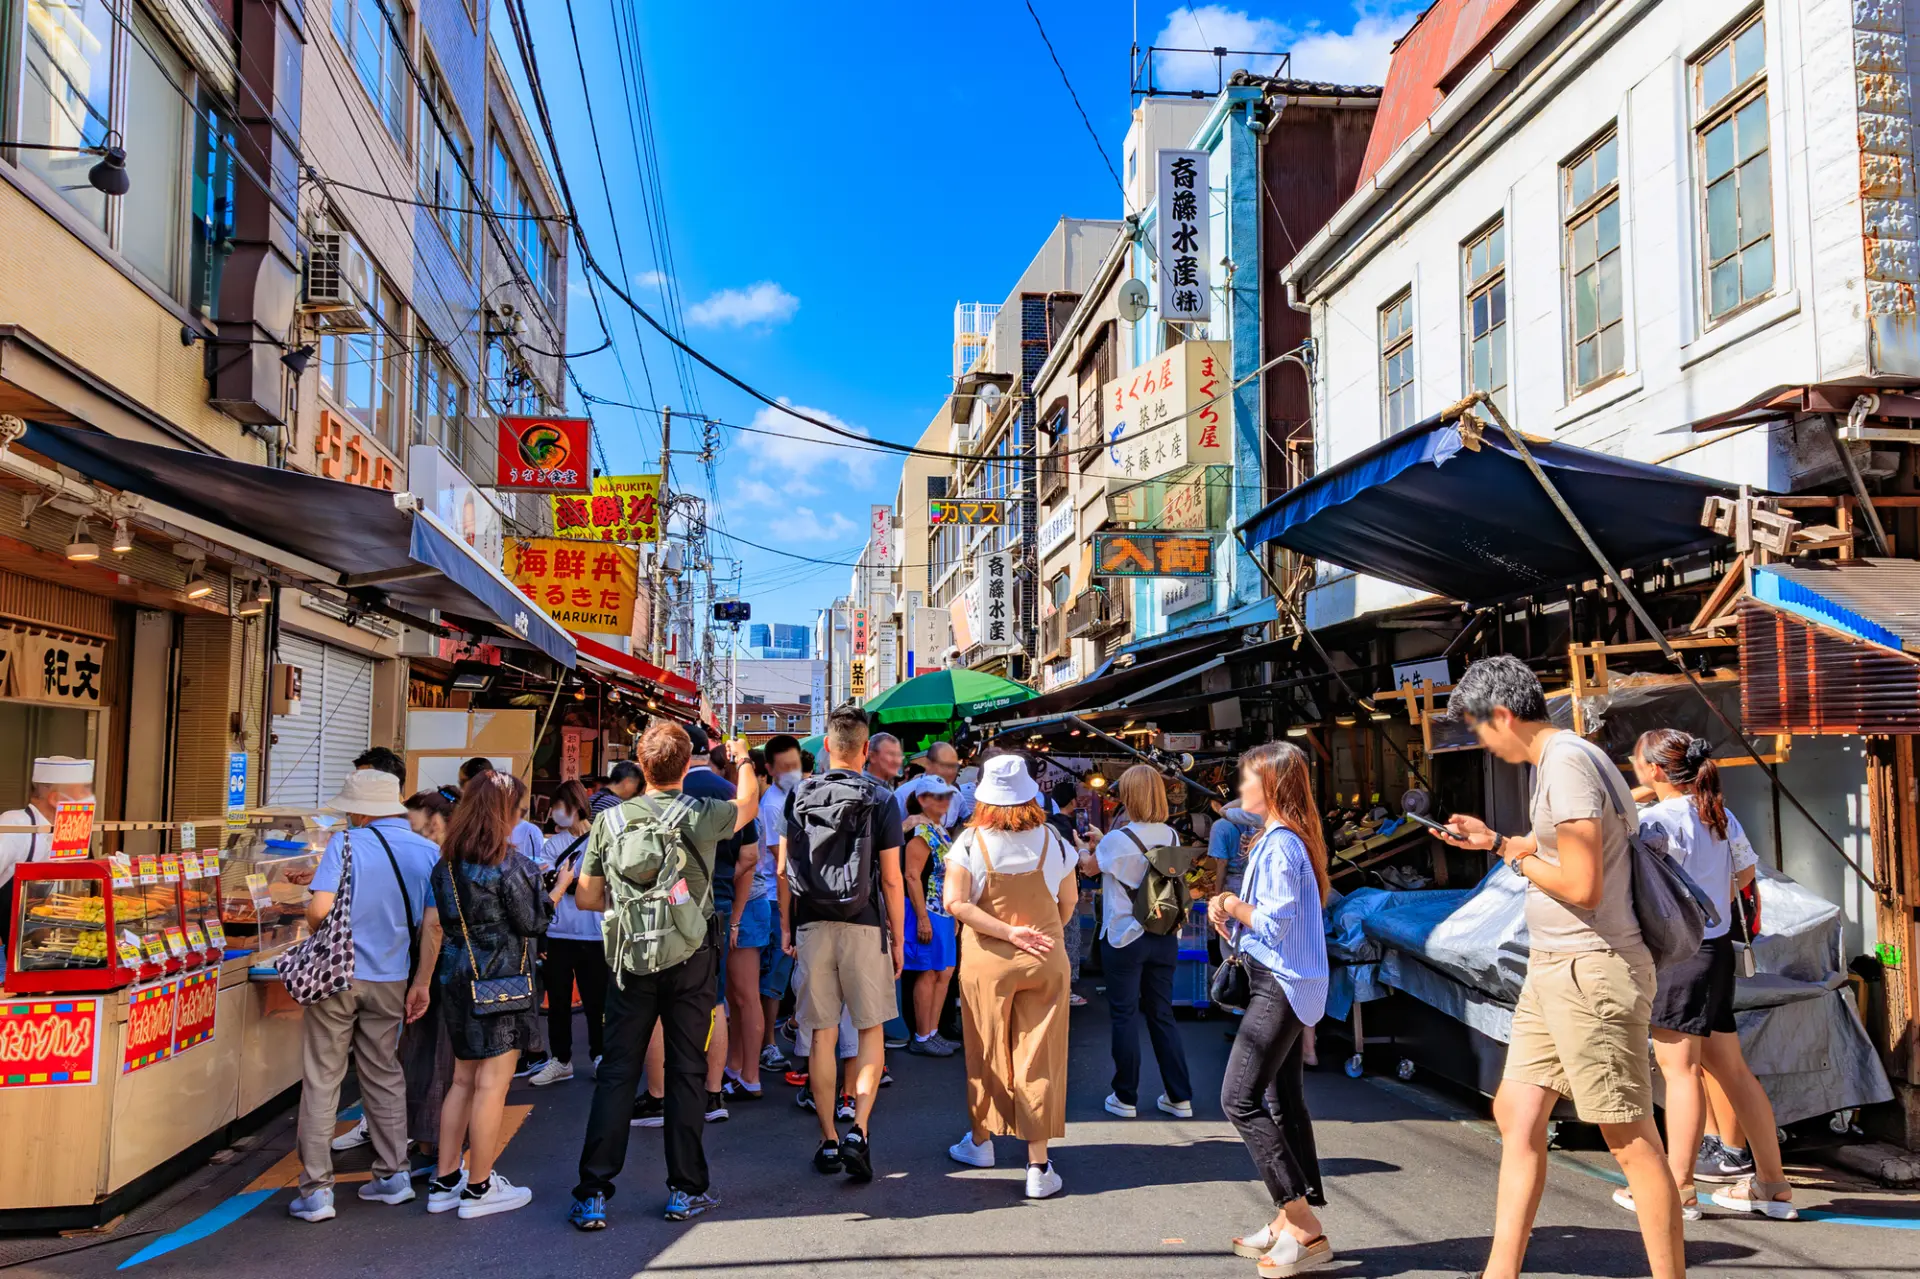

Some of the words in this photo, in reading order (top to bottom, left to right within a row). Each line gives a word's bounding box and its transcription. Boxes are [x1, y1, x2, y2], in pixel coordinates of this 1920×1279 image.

[1139, 398, 1168, 430] 築地
[1197, 356, 1221, 448] まぐろ屋
[510, 467, 577, 485] うなぎ食堂
[600, 482, 653, 492] MARUKITA
[556, 493, 657, 529] 海鮮丼
[940, 502, 999, 523] カマス
[516, 546, 622, 583] 海鮮丼
[1102, 538, 1210, 572] 入荷
[517, 583, 620, 610] まるきた
[552, 610, 617, 626] MARUKITA
[44, 648, 100, 700] 紀文
[852, 663, 864, 686] 茶
